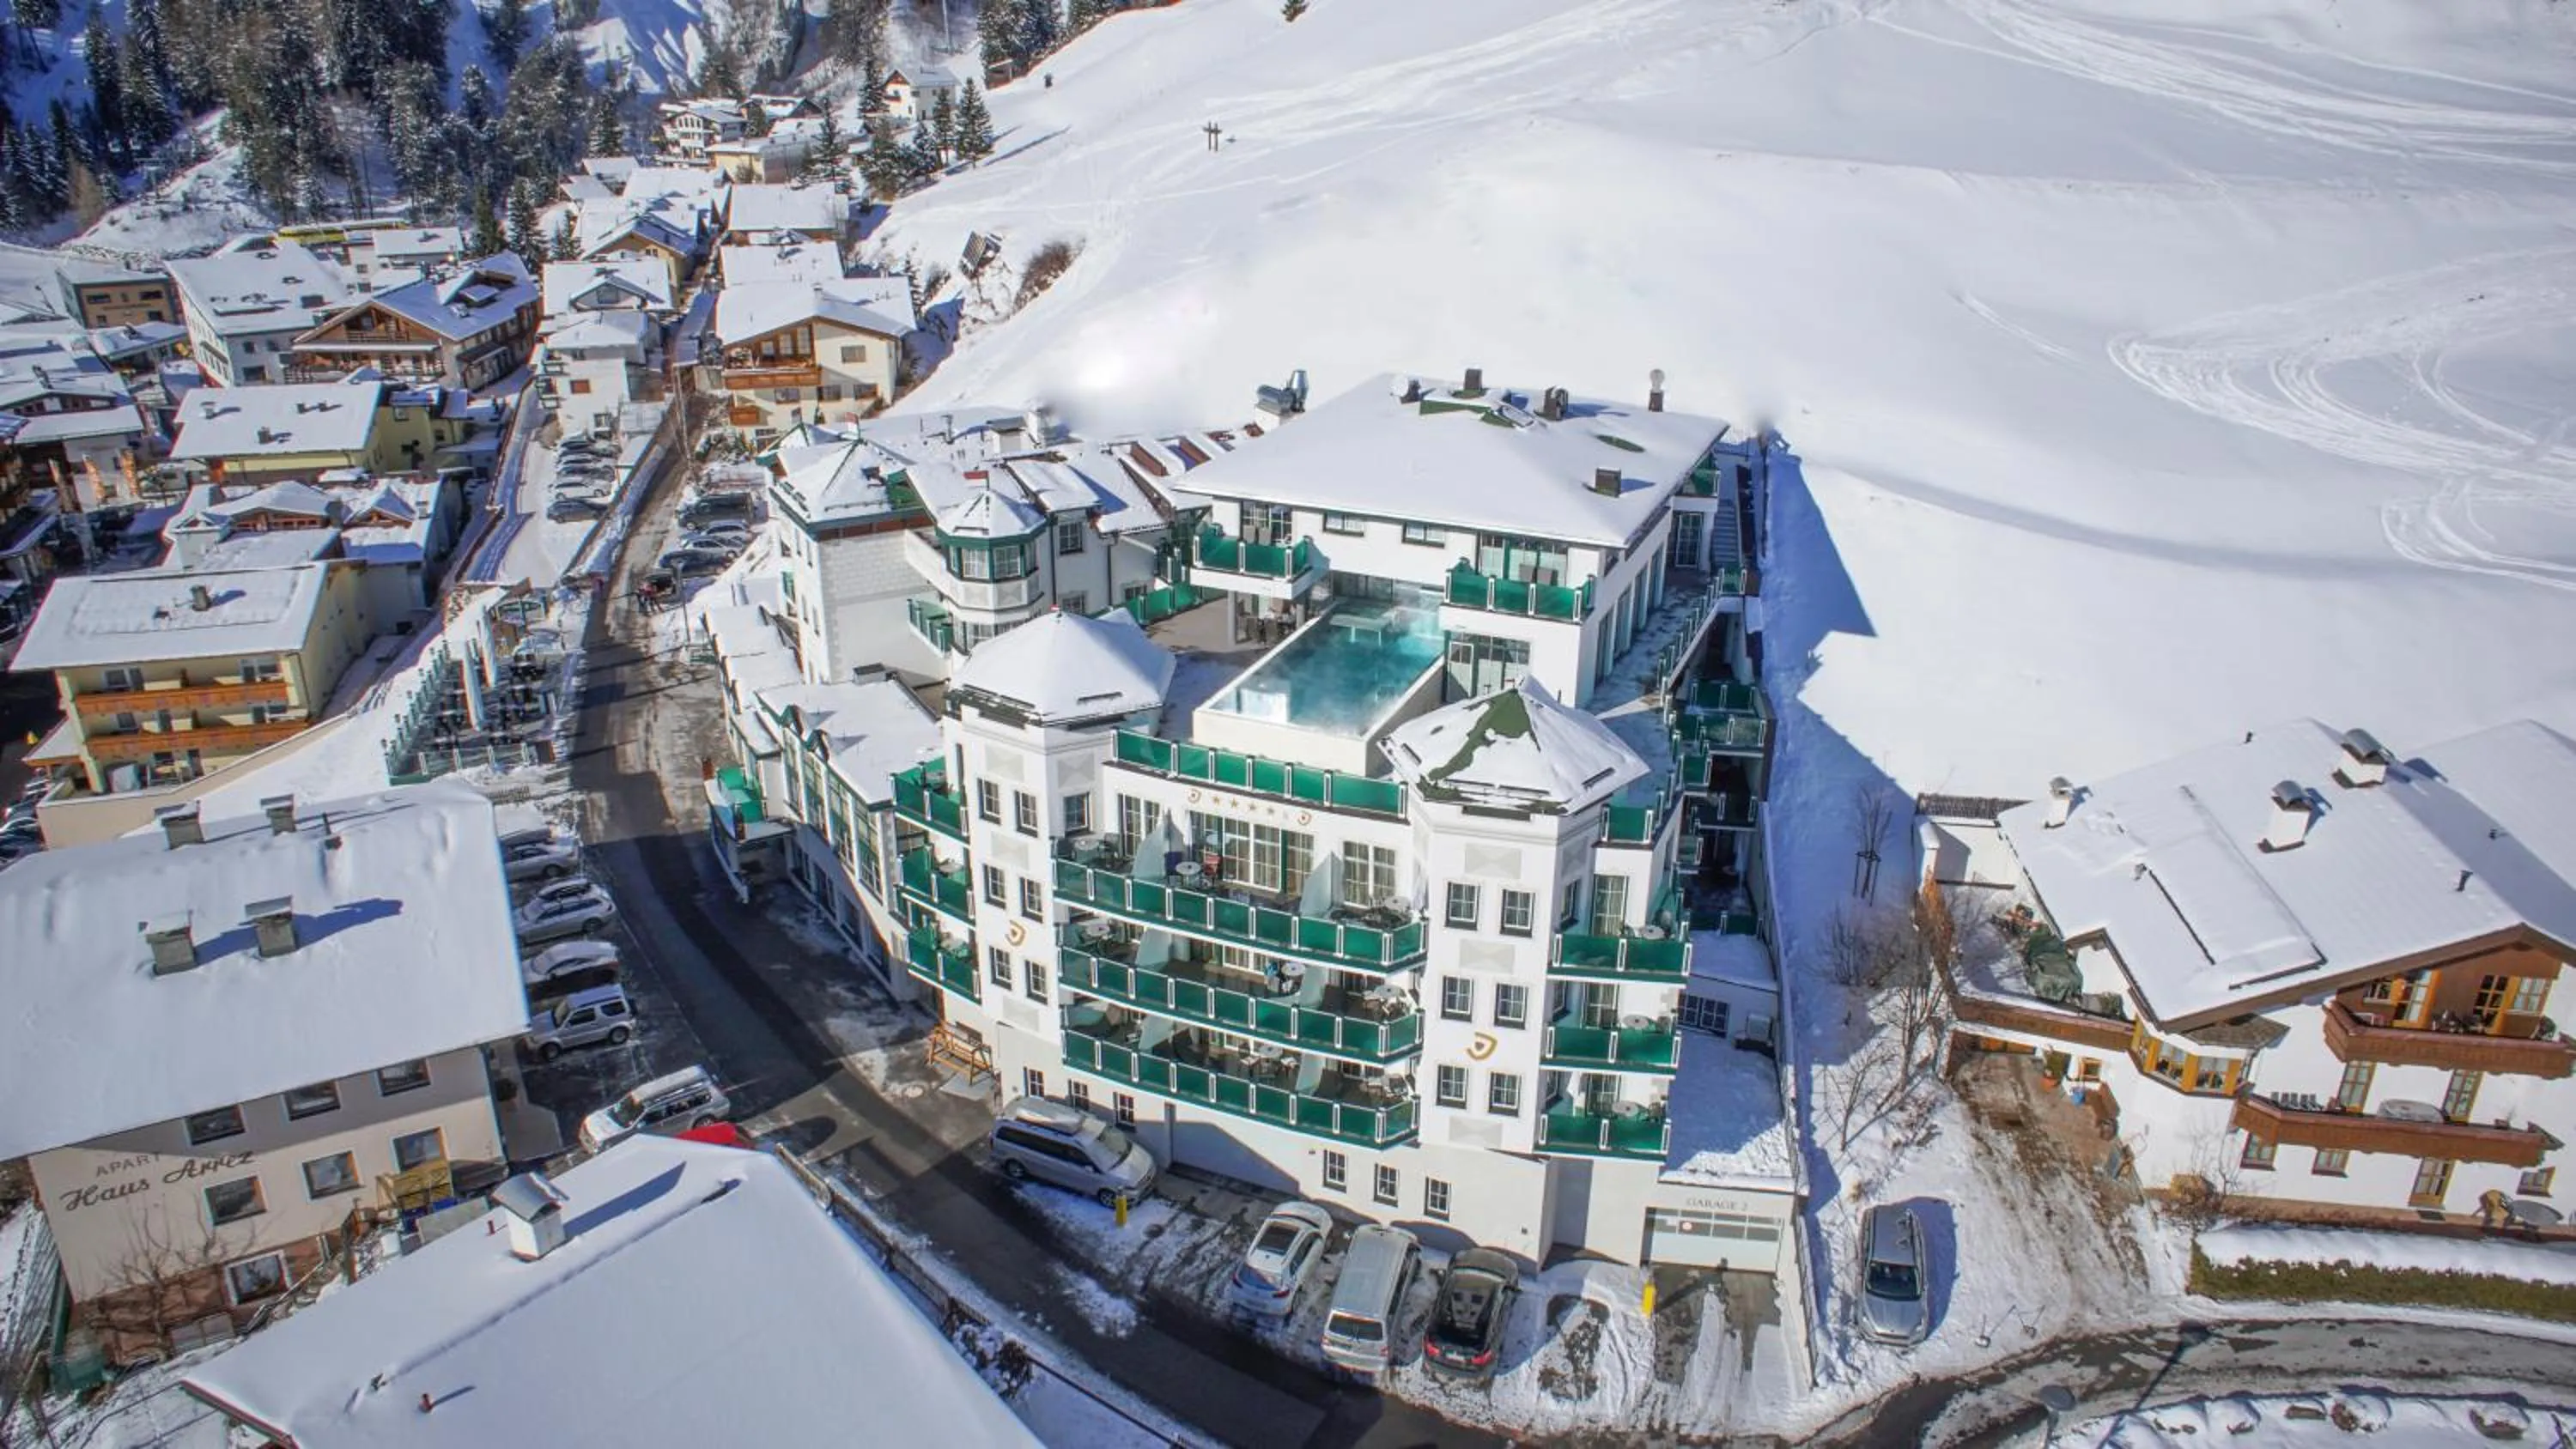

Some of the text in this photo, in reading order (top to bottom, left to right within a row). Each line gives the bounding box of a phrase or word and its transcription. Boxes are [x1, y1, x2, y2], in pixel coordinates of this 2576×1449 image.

[95, 1151, 161, 1178] APART
[59, 1178, 150, 1211] Haus
[1686, 1197, 1738, 1210] GARAGE
